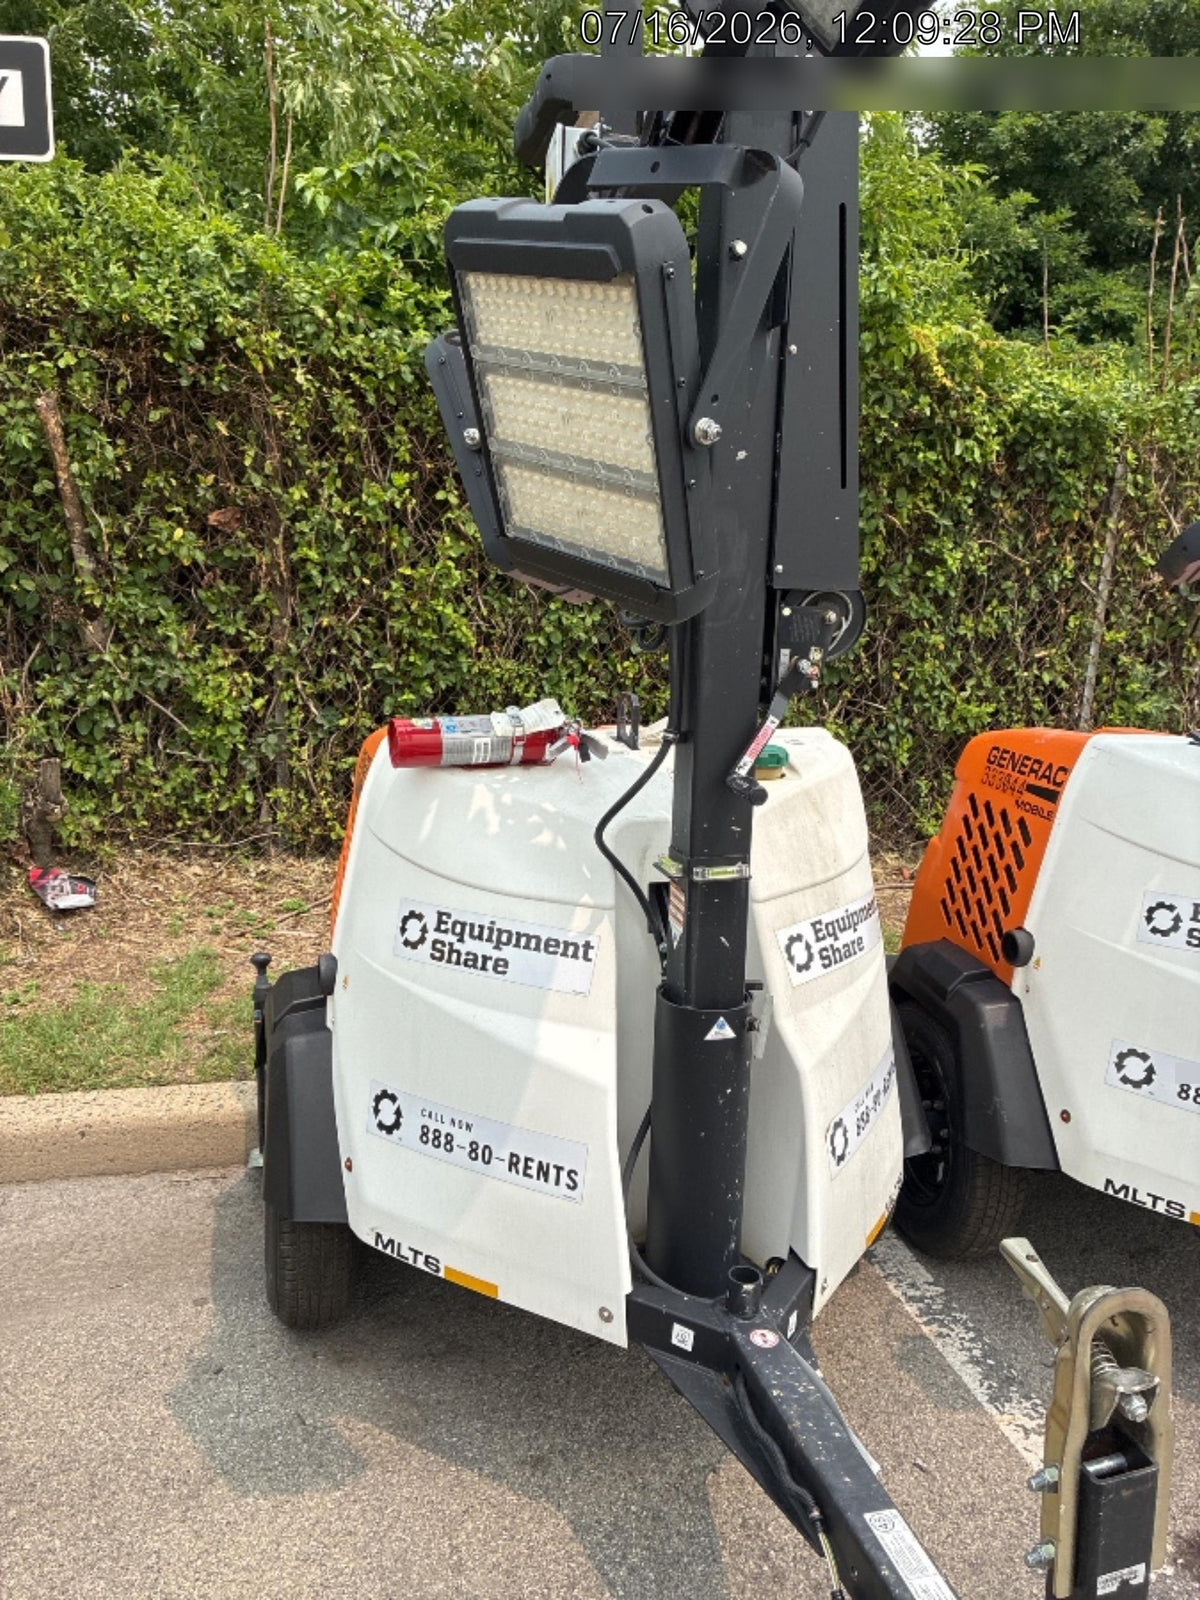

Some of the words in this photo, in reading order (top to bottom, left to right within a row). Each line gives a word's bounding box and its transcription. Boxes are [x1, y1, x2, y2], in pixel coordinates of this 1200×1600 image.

[986, 746, 1069, 788] GENERAC
[433, 910, 595, 962] Equipment
[817, 936, 865, 970] Share
[429, 938, 510, 976] Share
[420, 1107, 446, 1125] CALL
[449, 1117, 474, 1133] NOW
[418, 1125, 580, 1192] 888-80-RENTS
[1103, 1178, 1186, 1219] MLTS
[374, 1231, 441, 1275] MLTS
